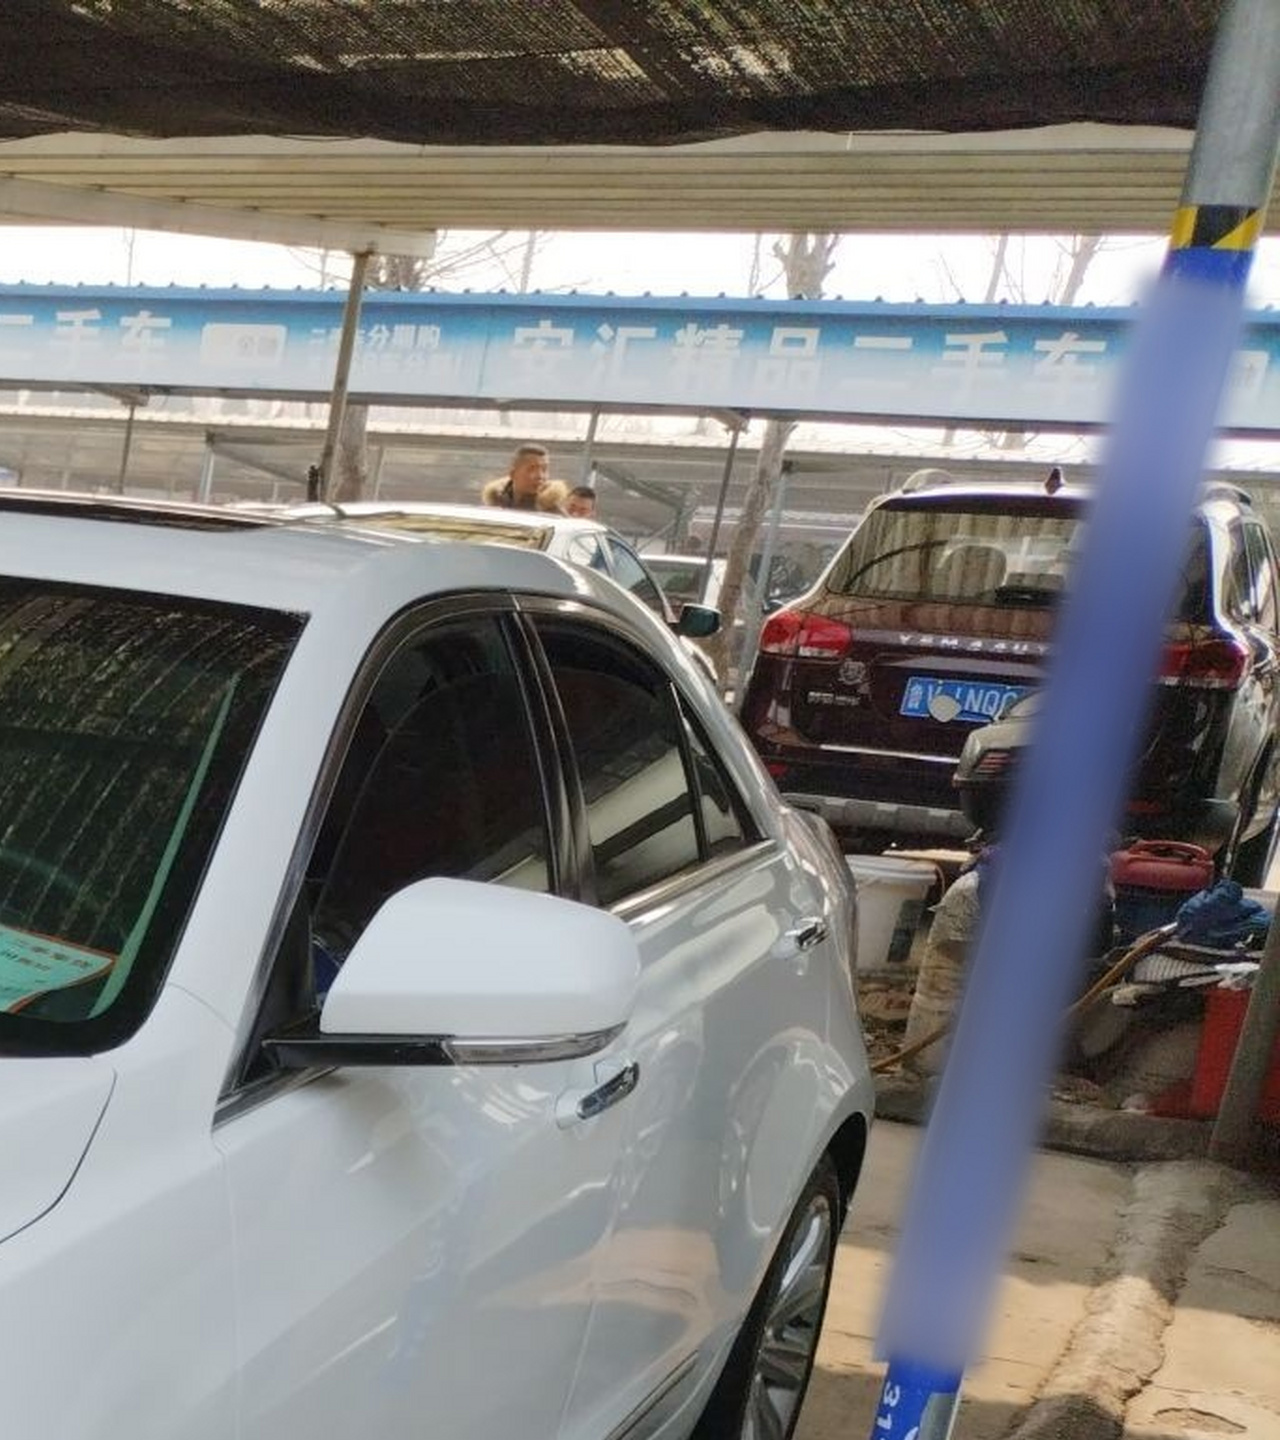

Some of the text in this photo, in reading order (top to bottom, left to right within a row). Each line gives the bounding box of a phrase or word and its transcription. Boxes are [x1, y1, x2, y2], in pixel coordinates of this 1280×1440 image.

[507, 319, 1108, 402] 安汇精品二手车
